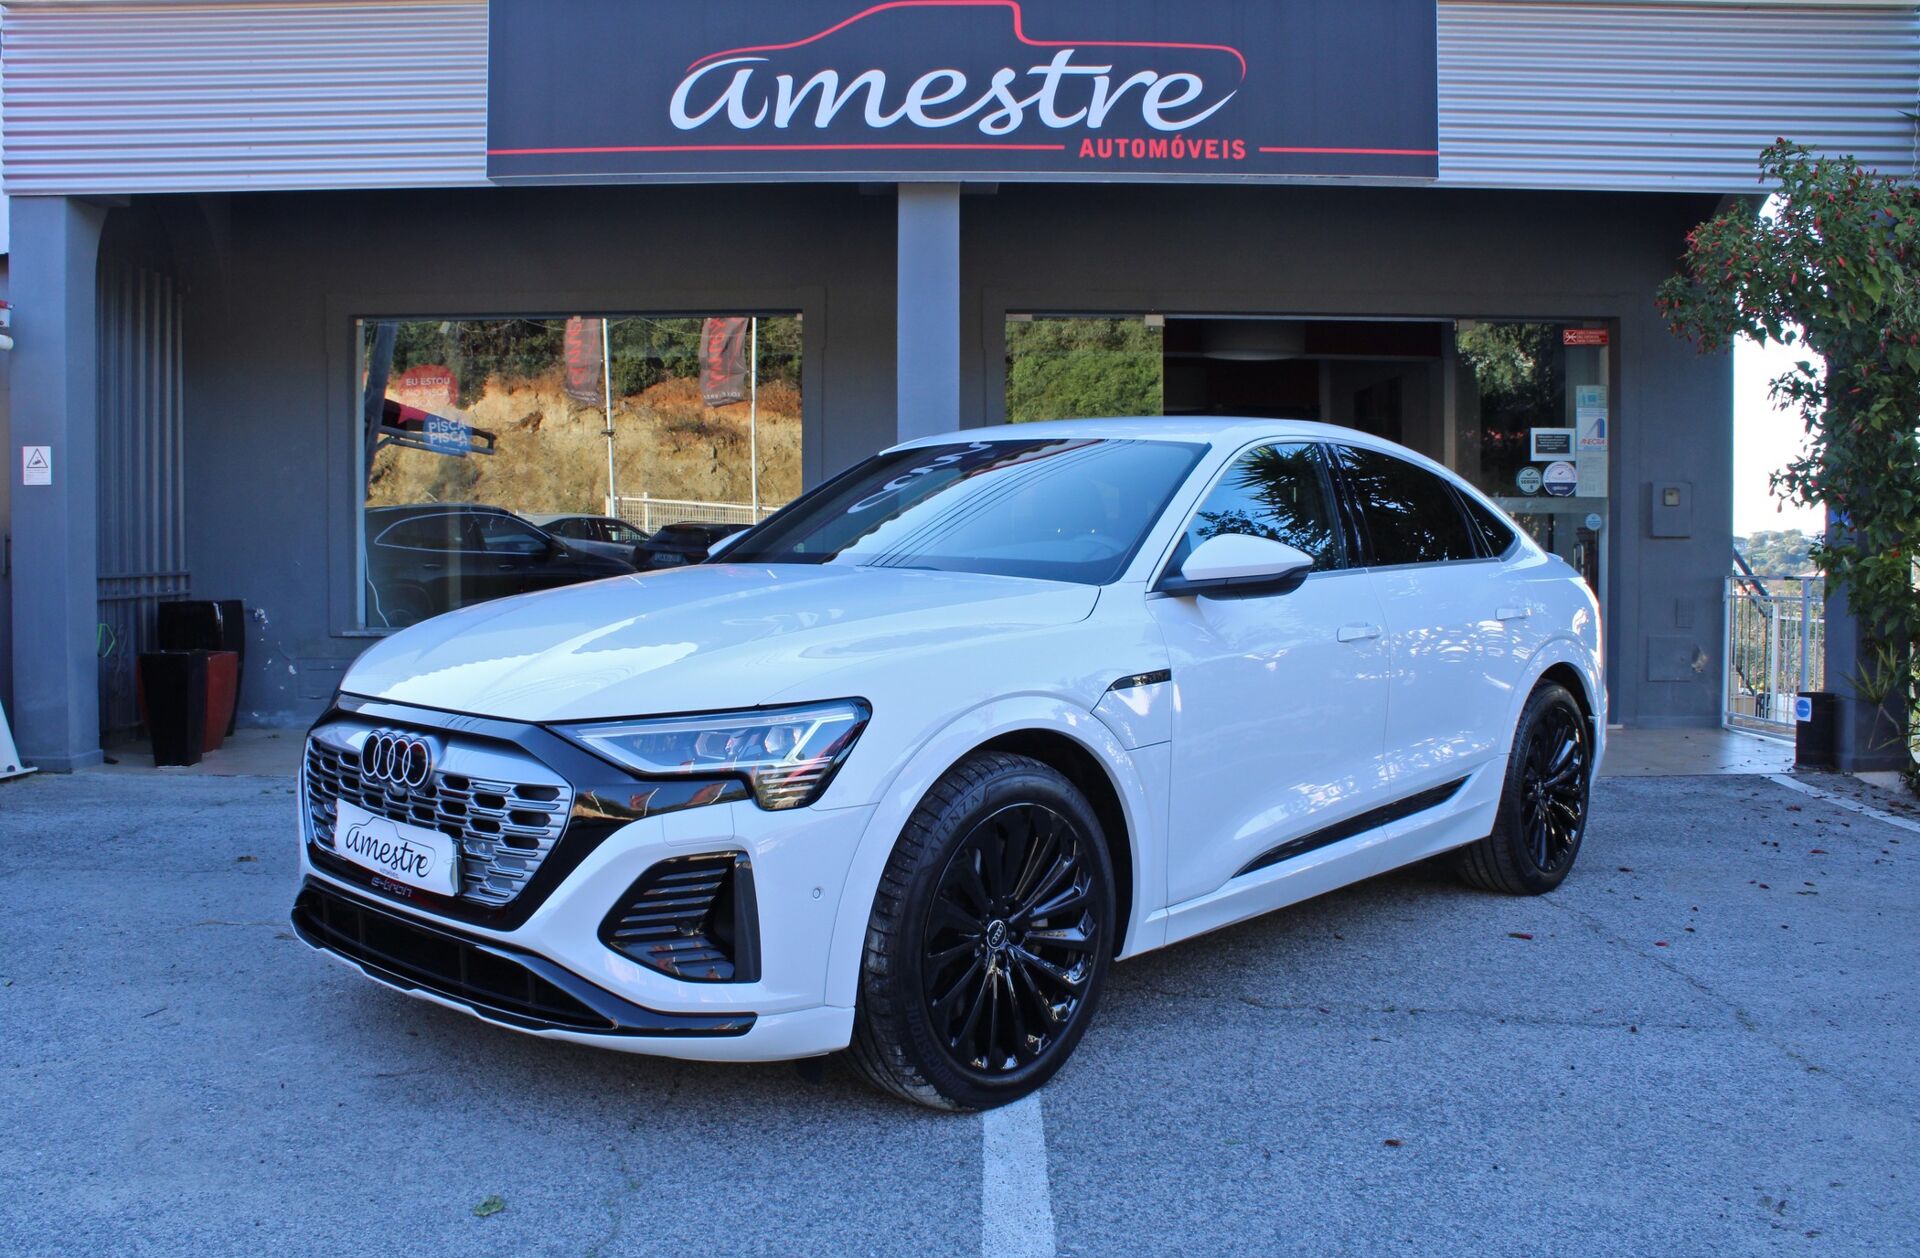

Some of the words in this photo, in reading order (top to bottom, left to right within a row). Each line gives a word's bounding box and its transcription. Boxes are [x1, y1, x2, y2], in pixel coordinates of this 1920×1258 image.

[669, 48, 1238, 135] amestre
[1079, 134, 1247, 160] AUTOMÓVEIS
[406, 378, 418, 386] EU
[420, 377, 450, 386] ESTOU
[346, 826, 429, 878] amestre
